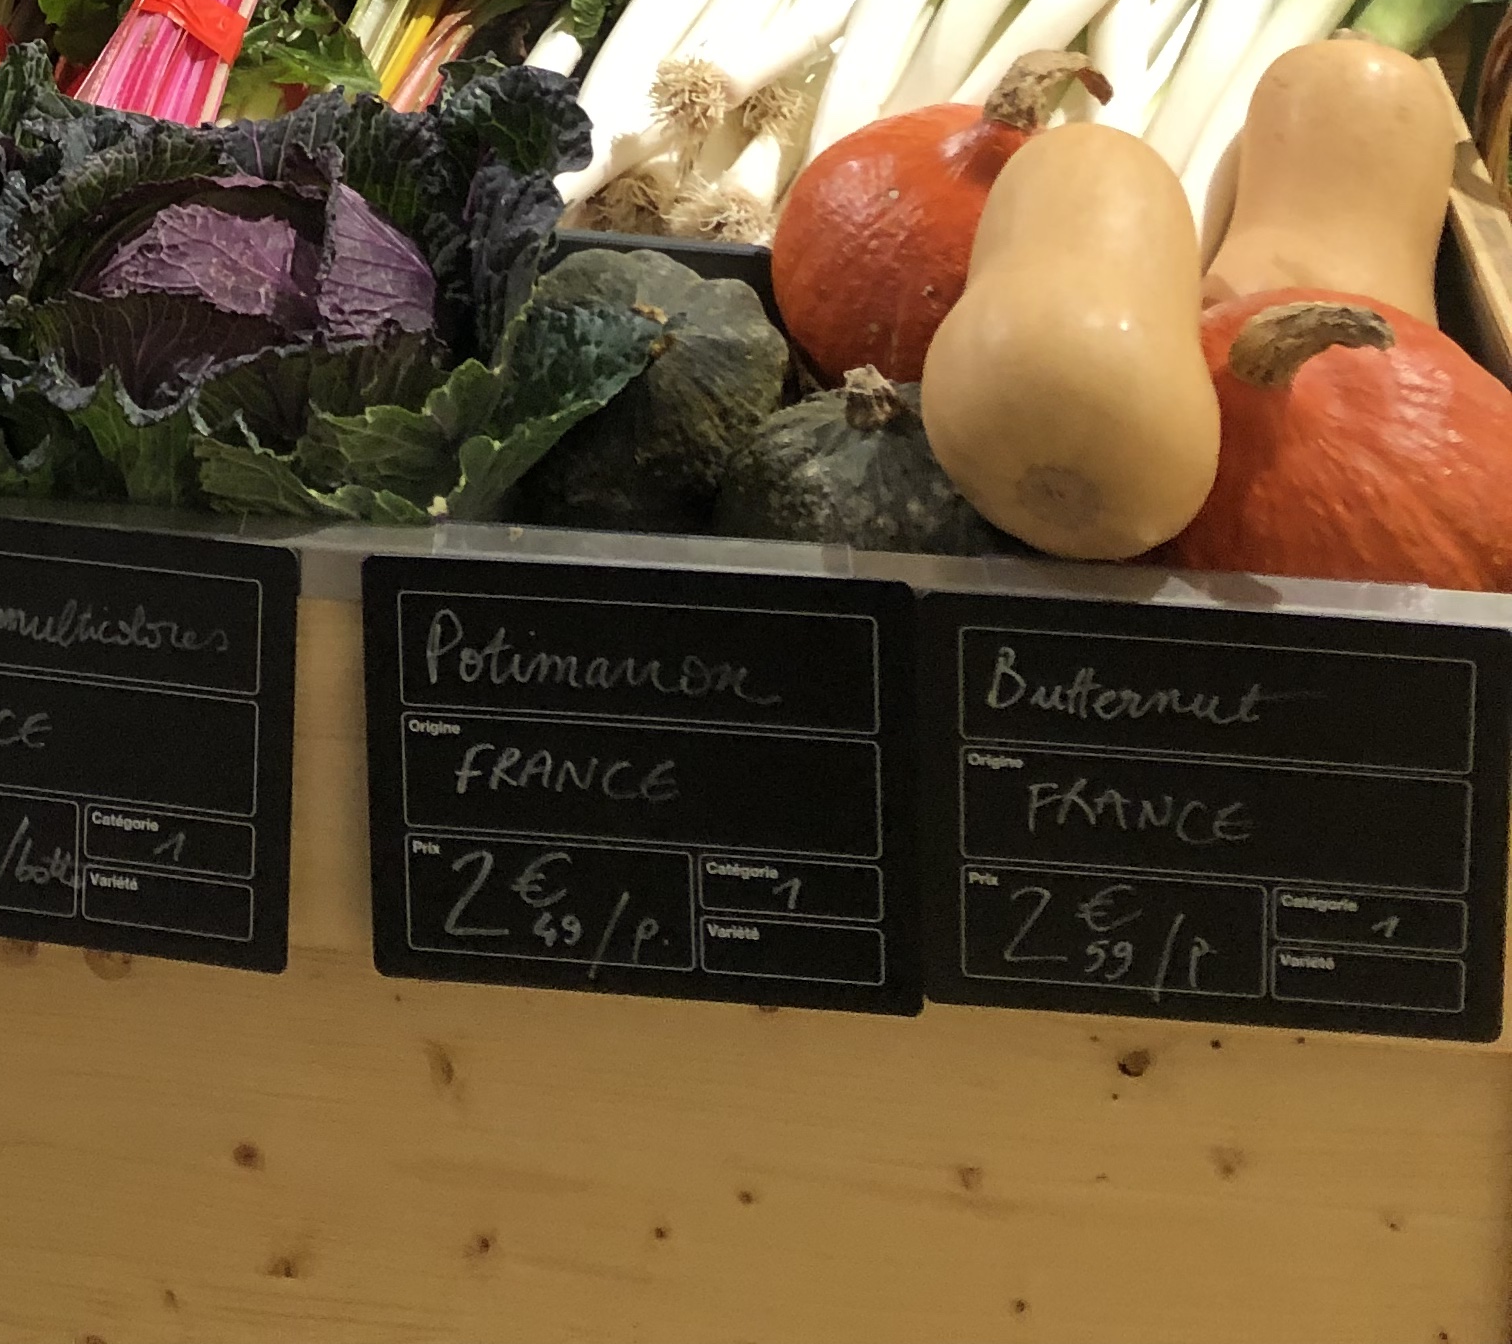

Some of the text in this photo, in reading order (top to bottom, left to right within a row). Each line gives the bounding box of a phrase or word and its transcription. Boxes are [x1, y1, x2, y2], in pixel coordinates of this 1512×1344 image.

[987, 646, 1263, 726] Butternut
[408, 720, 461, 737] Origine
[967, 753, 1024, 770] Origine
[454, 743, 681, 801] FRANCE
[1027, 778, 1253, 844] FRANCE
[91, 811, 186, 862] Catégorie 1
[412, 840, 441, 856] Prix
[89, 873, 138, 891] Variété
[706, 861, 802, 909] Catégorie 1
[967, 872, 999, 887] Prix
[1281, 893, 1401, 937] Catégorie 1
[707, 923, 761, 941] Variété
[1281, 953, 1336, 971] Variété
